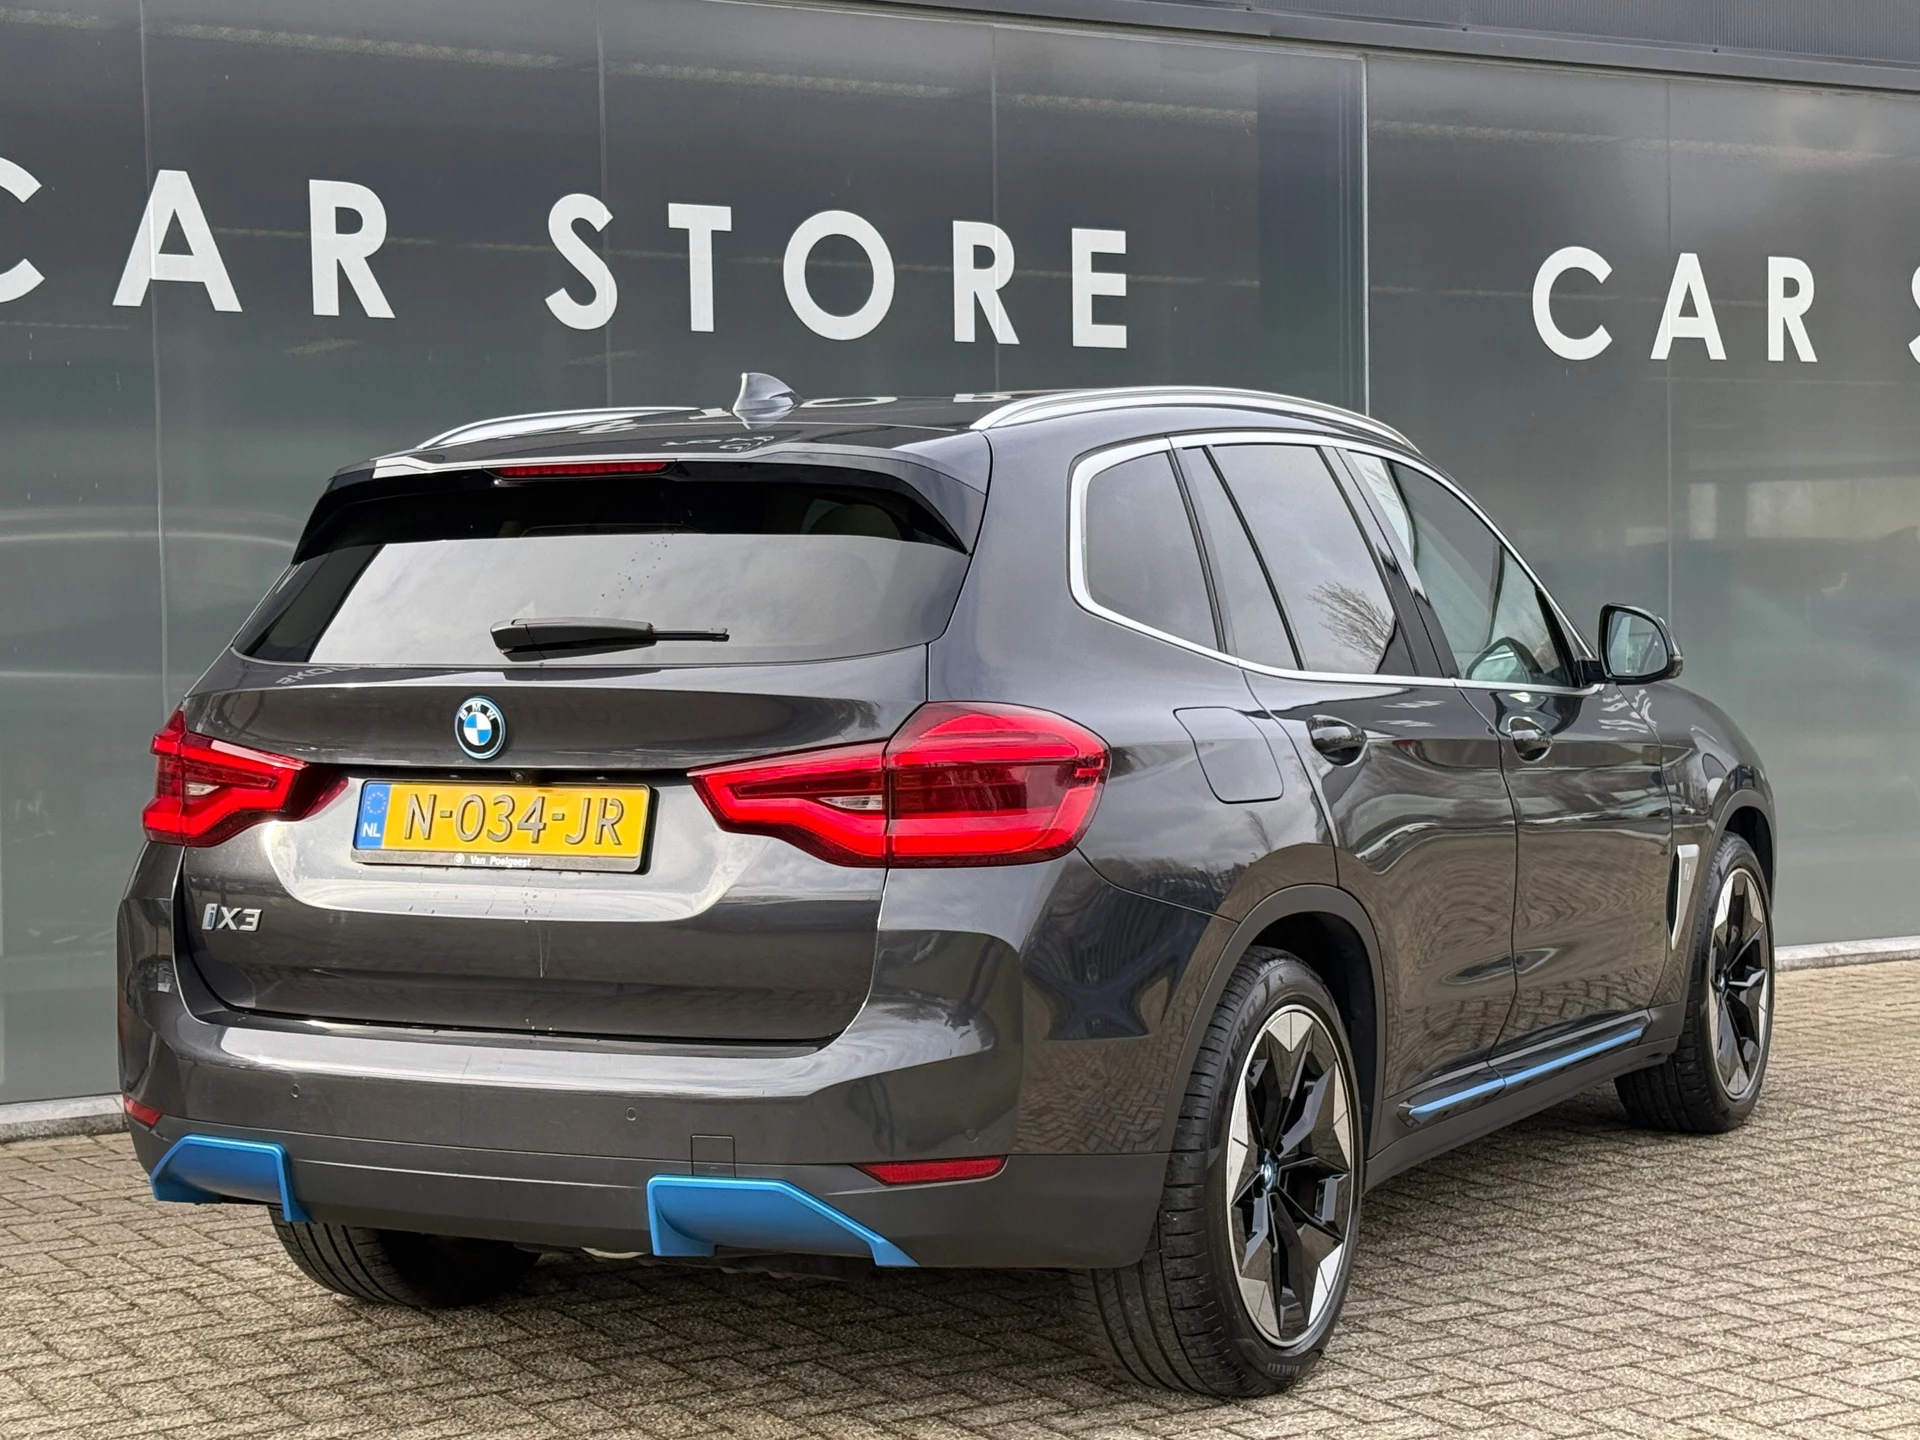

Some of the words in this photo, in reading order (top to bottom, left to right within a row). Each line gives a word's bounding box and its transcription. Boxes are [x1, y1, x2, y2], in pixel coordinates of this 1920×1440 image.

[545, 193, 1127, 349] STORE
[1533, 247, 1818, 361] CAR
[459, 702, 497, 721] BMW
[362, 822, 381, 838] NL
[404, 794, 624, 845] N-034-JR
[470, 855, 487, 865] Van
